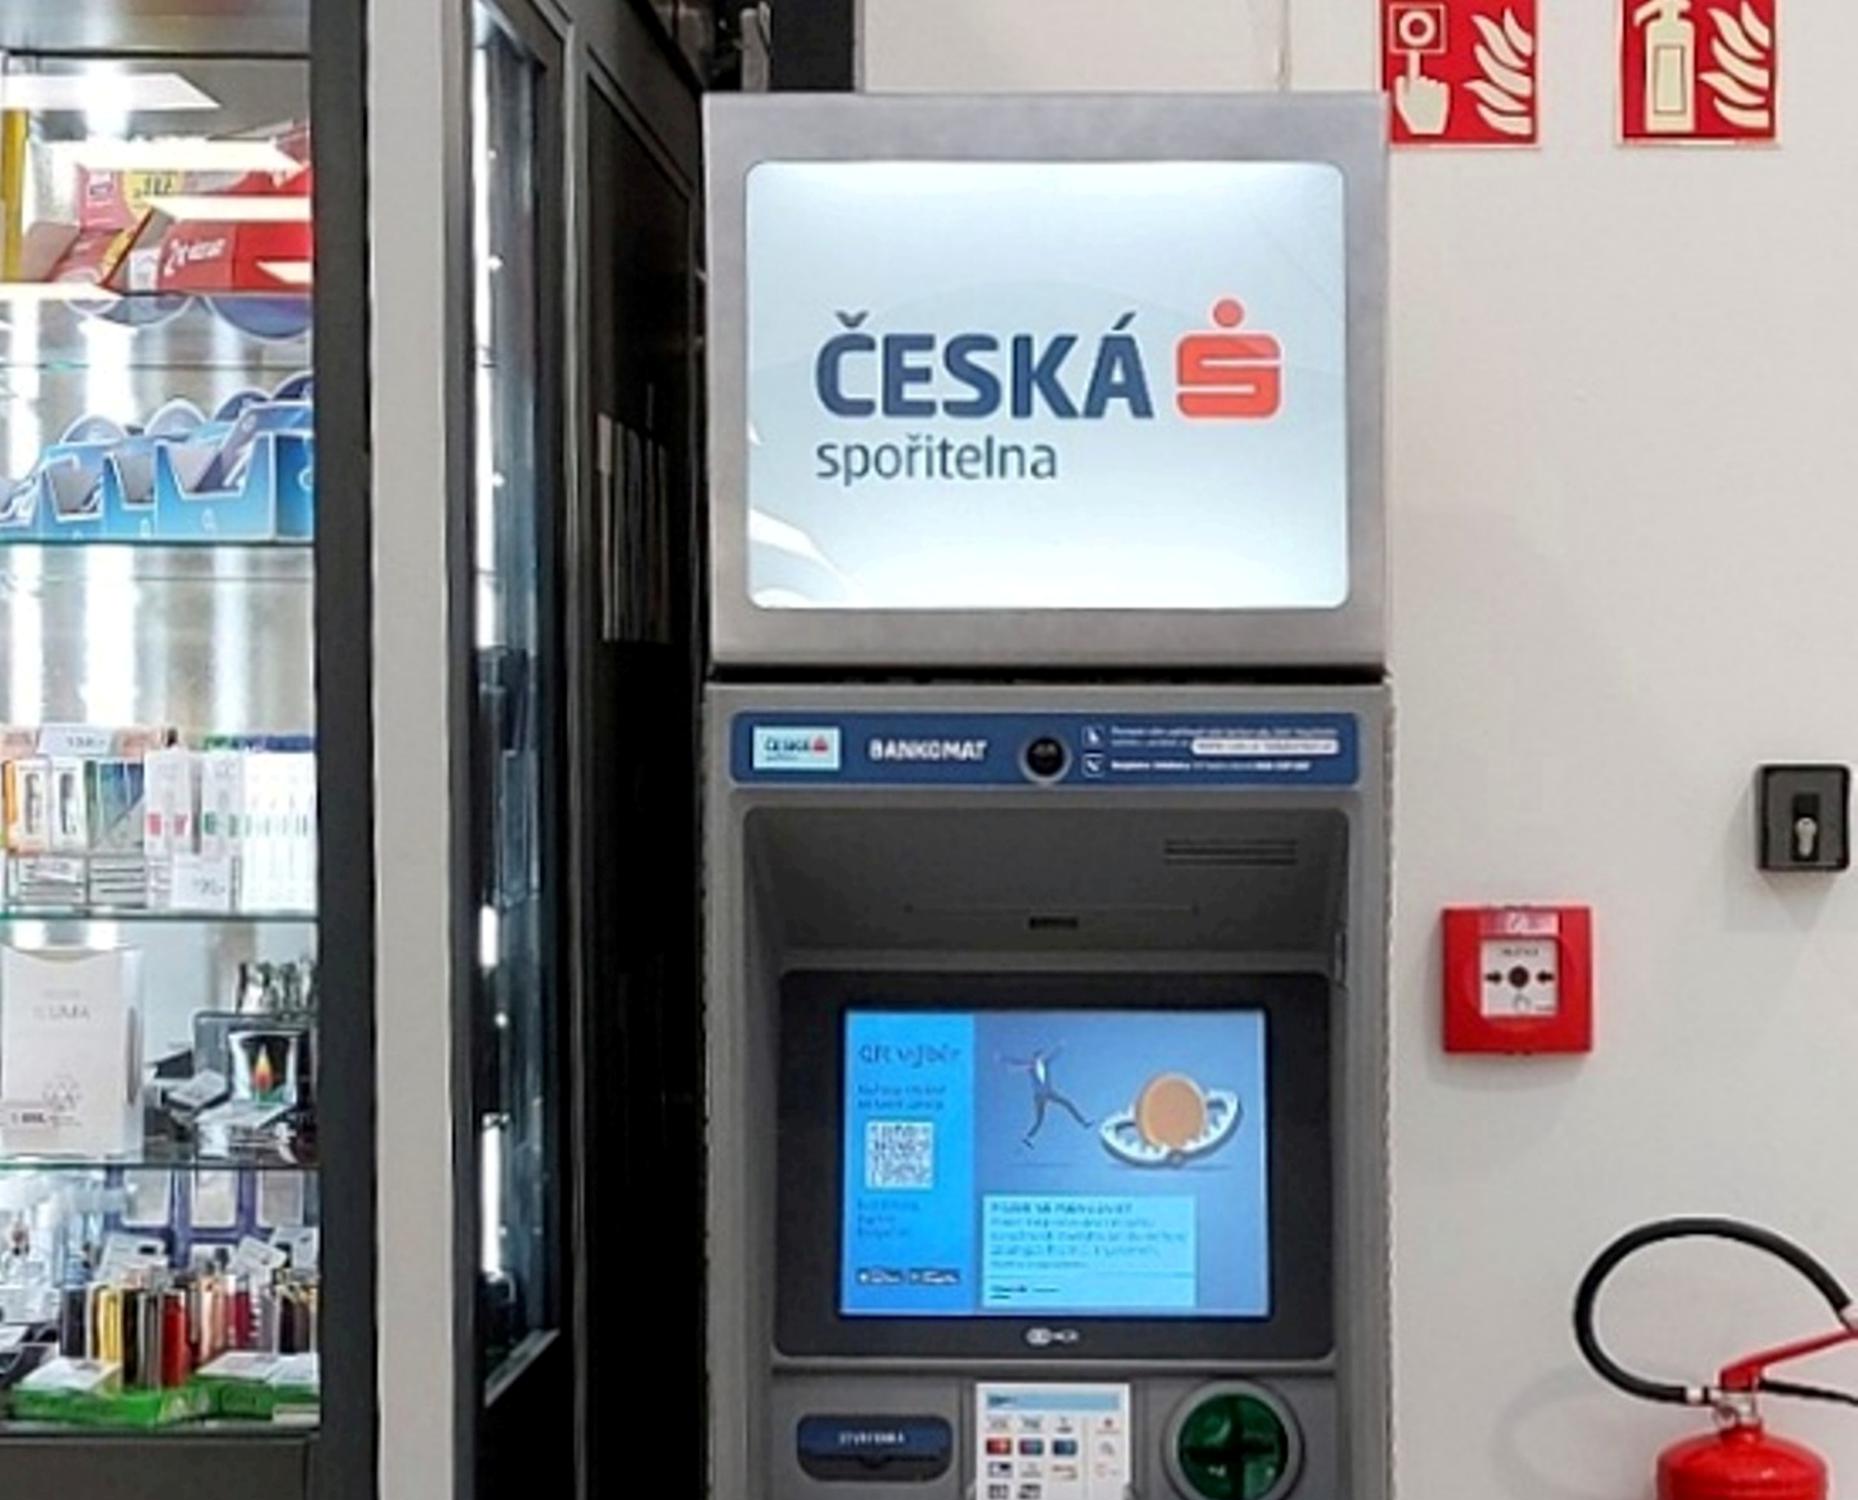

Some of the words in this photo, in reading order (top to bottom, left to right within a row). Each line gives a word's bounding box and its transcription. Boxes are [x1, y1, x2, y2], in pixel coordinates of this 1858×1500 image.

[815, 310, 1155, 419] ČESKÁ
[816, 434, 1058, 487] spořitelna
[869, 738, 988, 761] BANKOMAT
